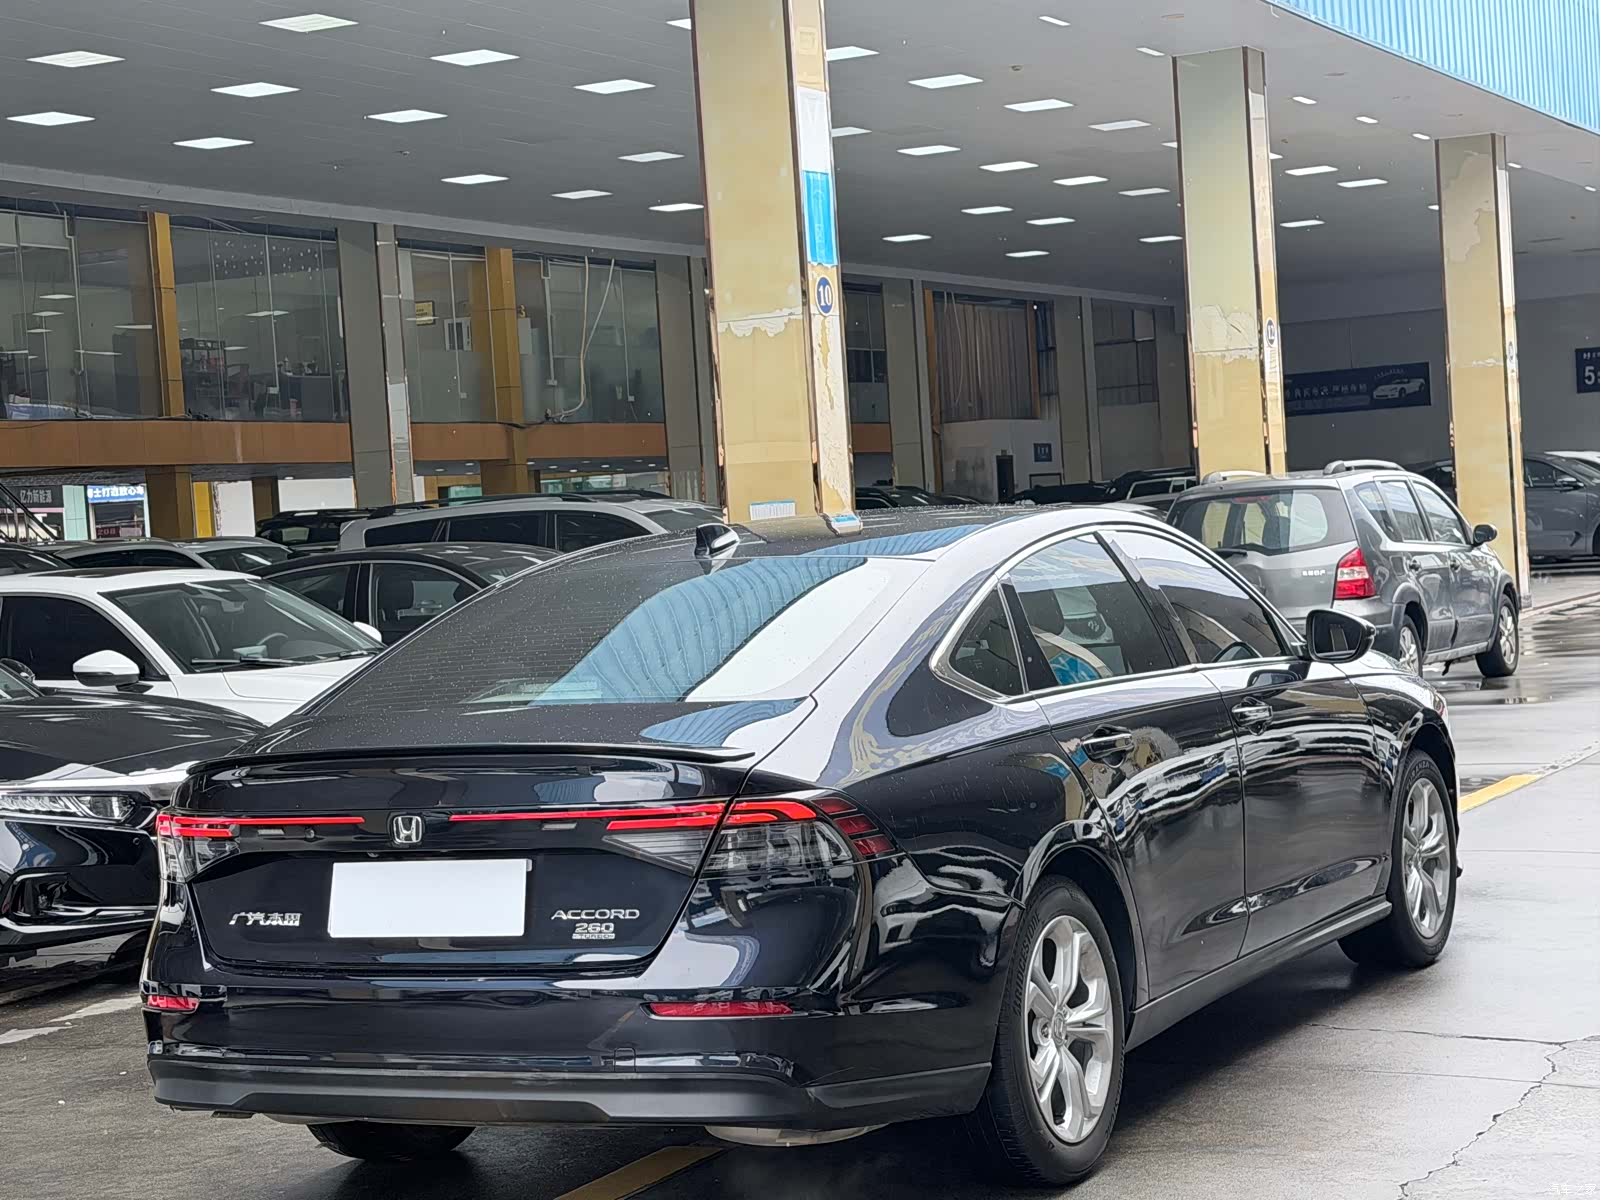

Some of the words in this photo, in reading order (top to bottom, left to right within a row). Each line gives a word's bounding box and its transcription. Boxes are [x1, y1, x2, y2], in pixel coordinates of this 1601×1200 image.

[818, 284, 832, 306] 10
[1584, 365, 1600, 385] 5
[20, 489, 52, 504] 亿力新能源
[229, 911, 302, 927] 广汽本田
[550, 909, 640, 920] ACCORD
[574, 922, 615, 933] 260
